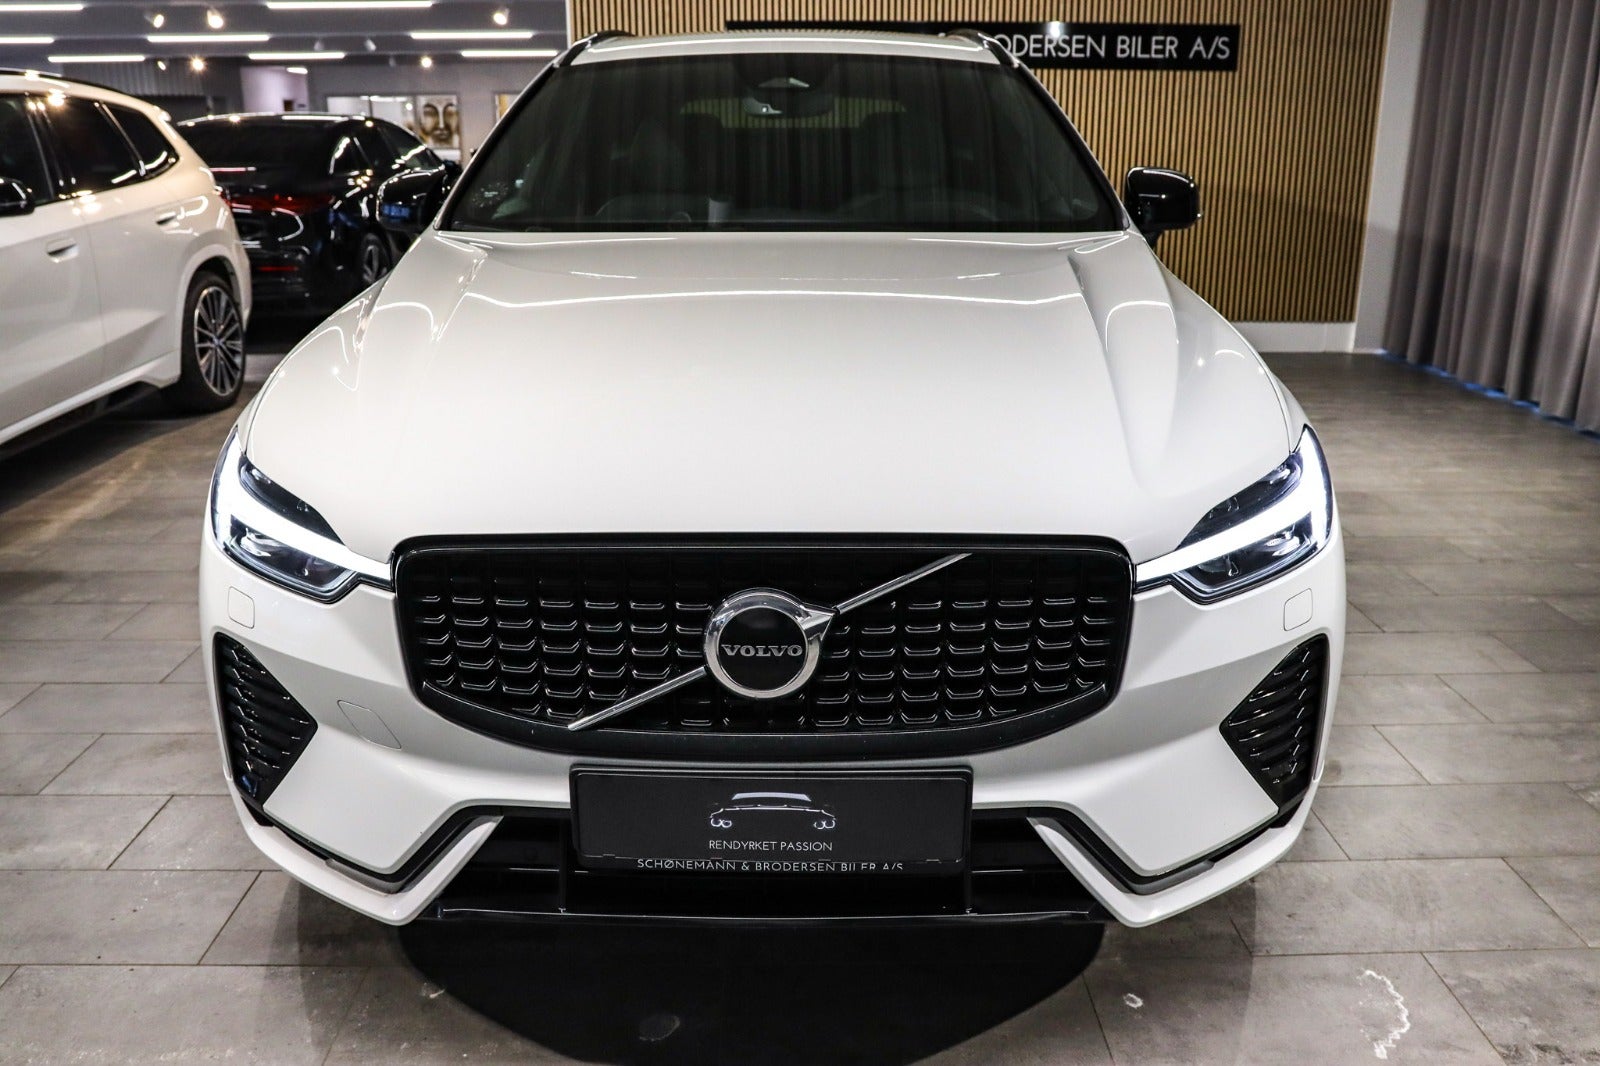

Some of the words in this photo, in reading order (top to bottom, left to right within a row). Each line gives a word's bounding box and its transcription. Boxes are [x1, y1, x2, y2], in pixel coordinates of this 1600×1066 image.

[1116, 35, 1179, 59] BILER
[1188, 36, 1230, 60] A/S
[721, 644, 803, 657] VOLVO
[709, 840, 778, 851] RENDYRKET
[780, 841, 833, 852] PASSION
[637, 858, 736, 871] SCHØNEMANN
[741, 861, 750, 871] &
[755, 862, 836, 872] BRODERSEN
